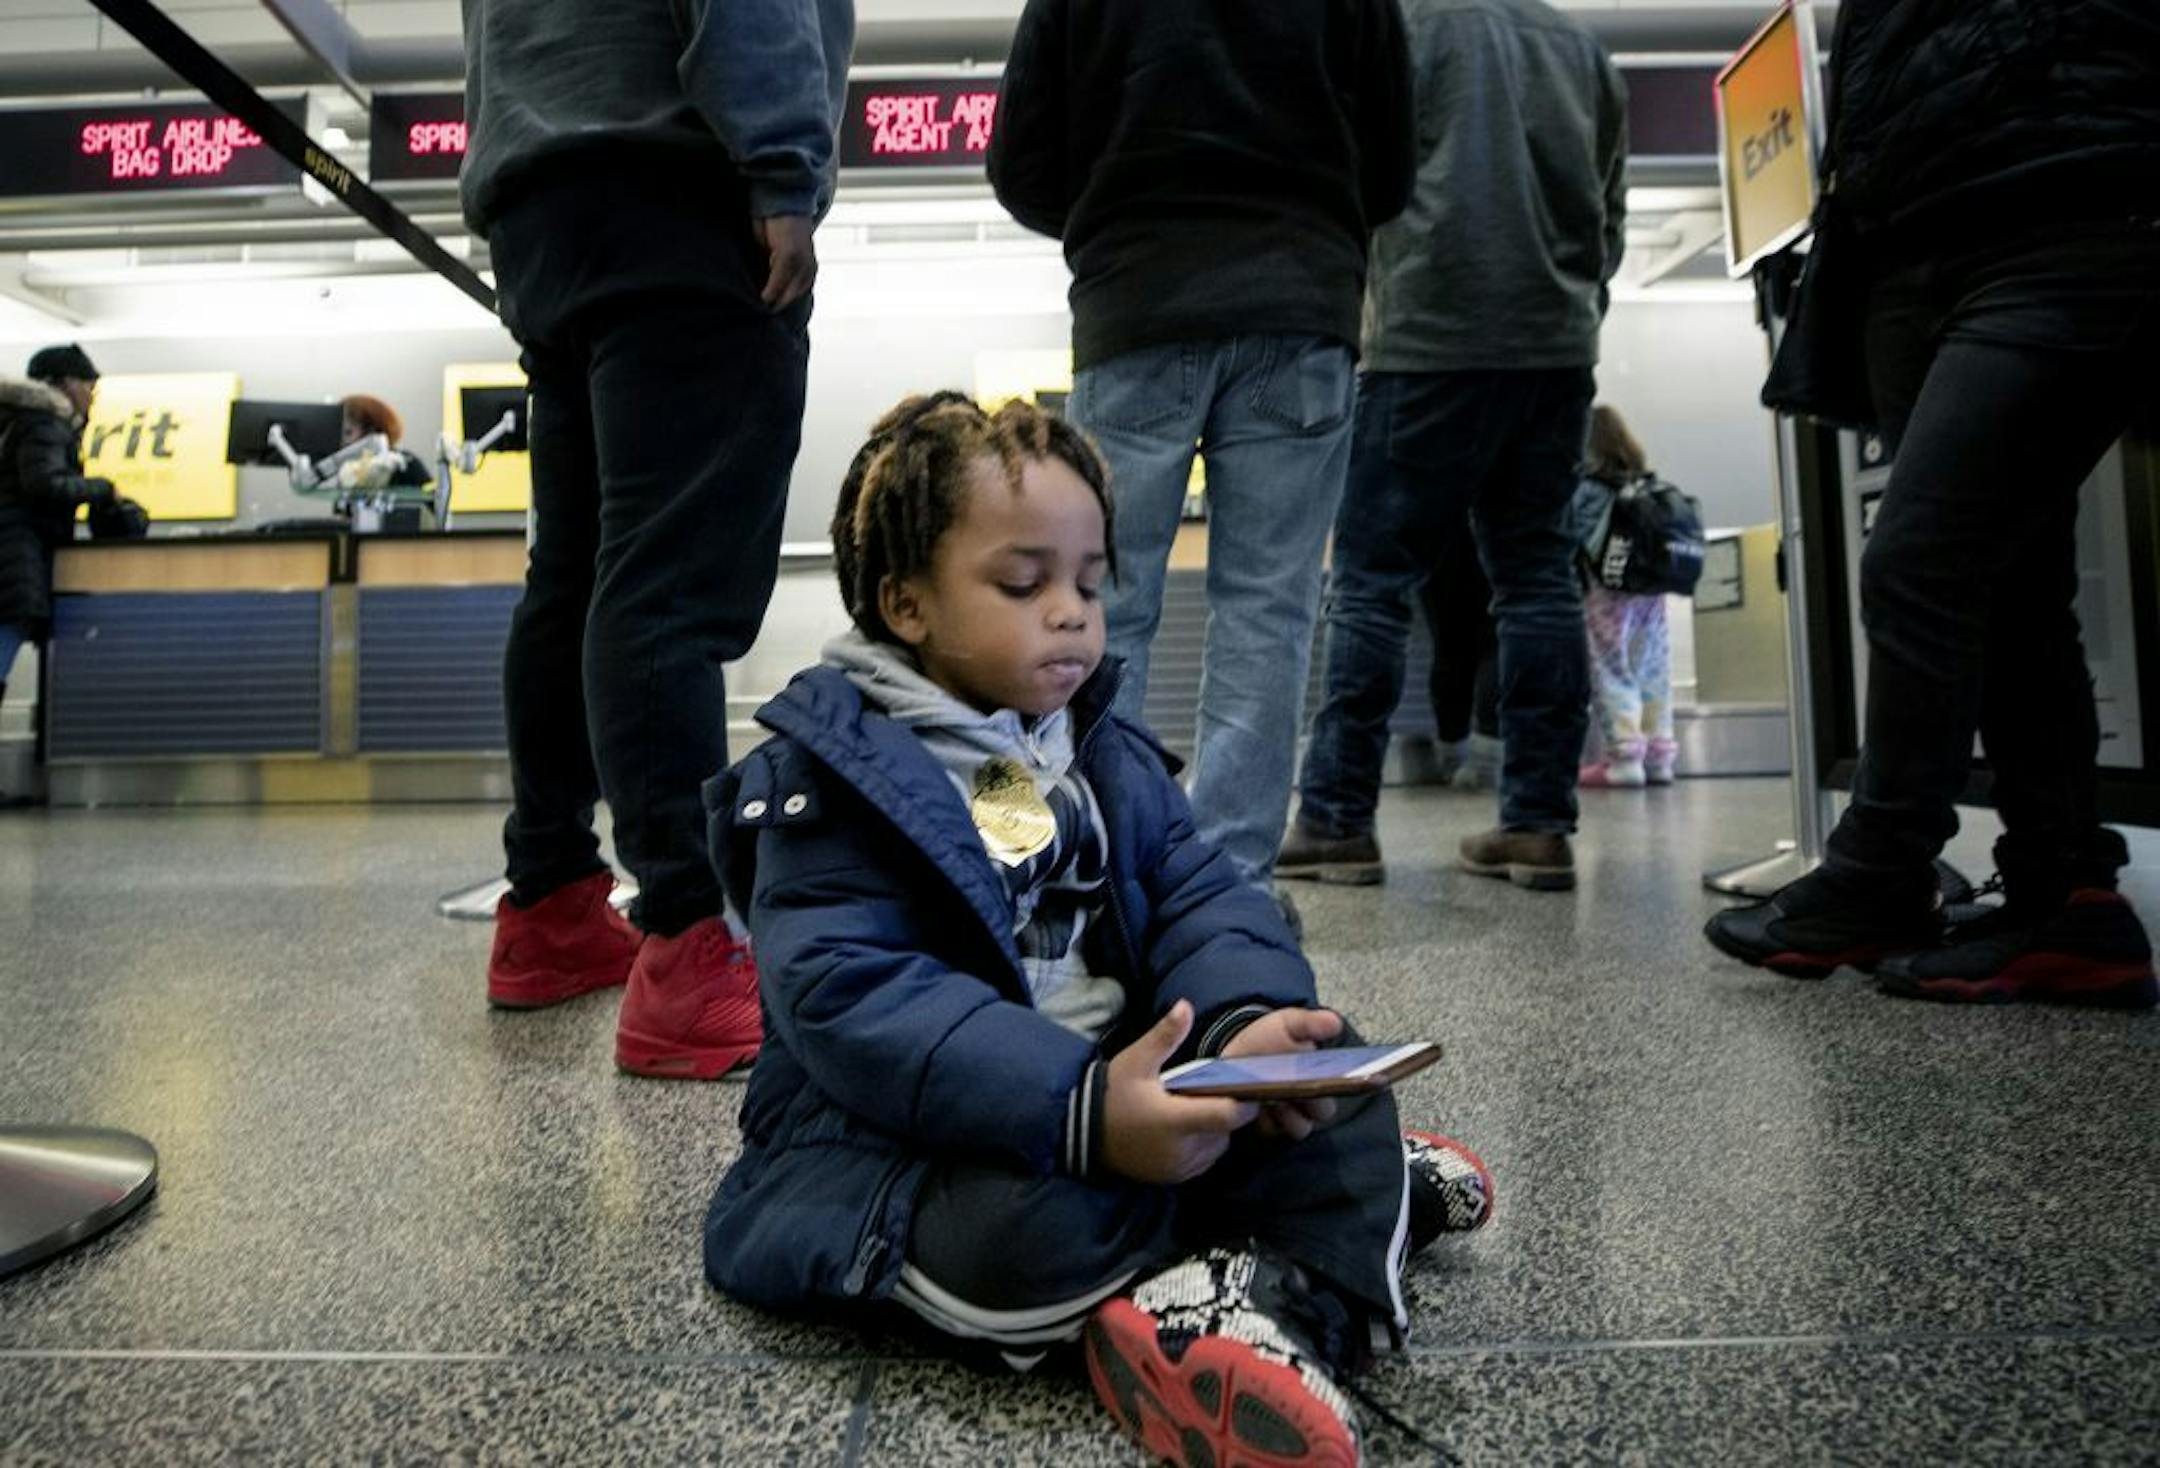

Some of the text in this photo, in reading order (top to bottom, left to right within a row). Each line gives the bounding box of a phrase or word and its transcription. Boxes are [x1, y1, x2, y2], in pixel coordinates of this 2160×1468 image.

[865, 96, 938, 126] SPIRIT
[82, 122, 151, 153] SPIRIT
[873, 121, 952, 152] AGENT
[1741, 107, 1794, 180] Exit
[112, 145, 232, 177] BAG DROP
[304, 147, 351, 195] spirit
